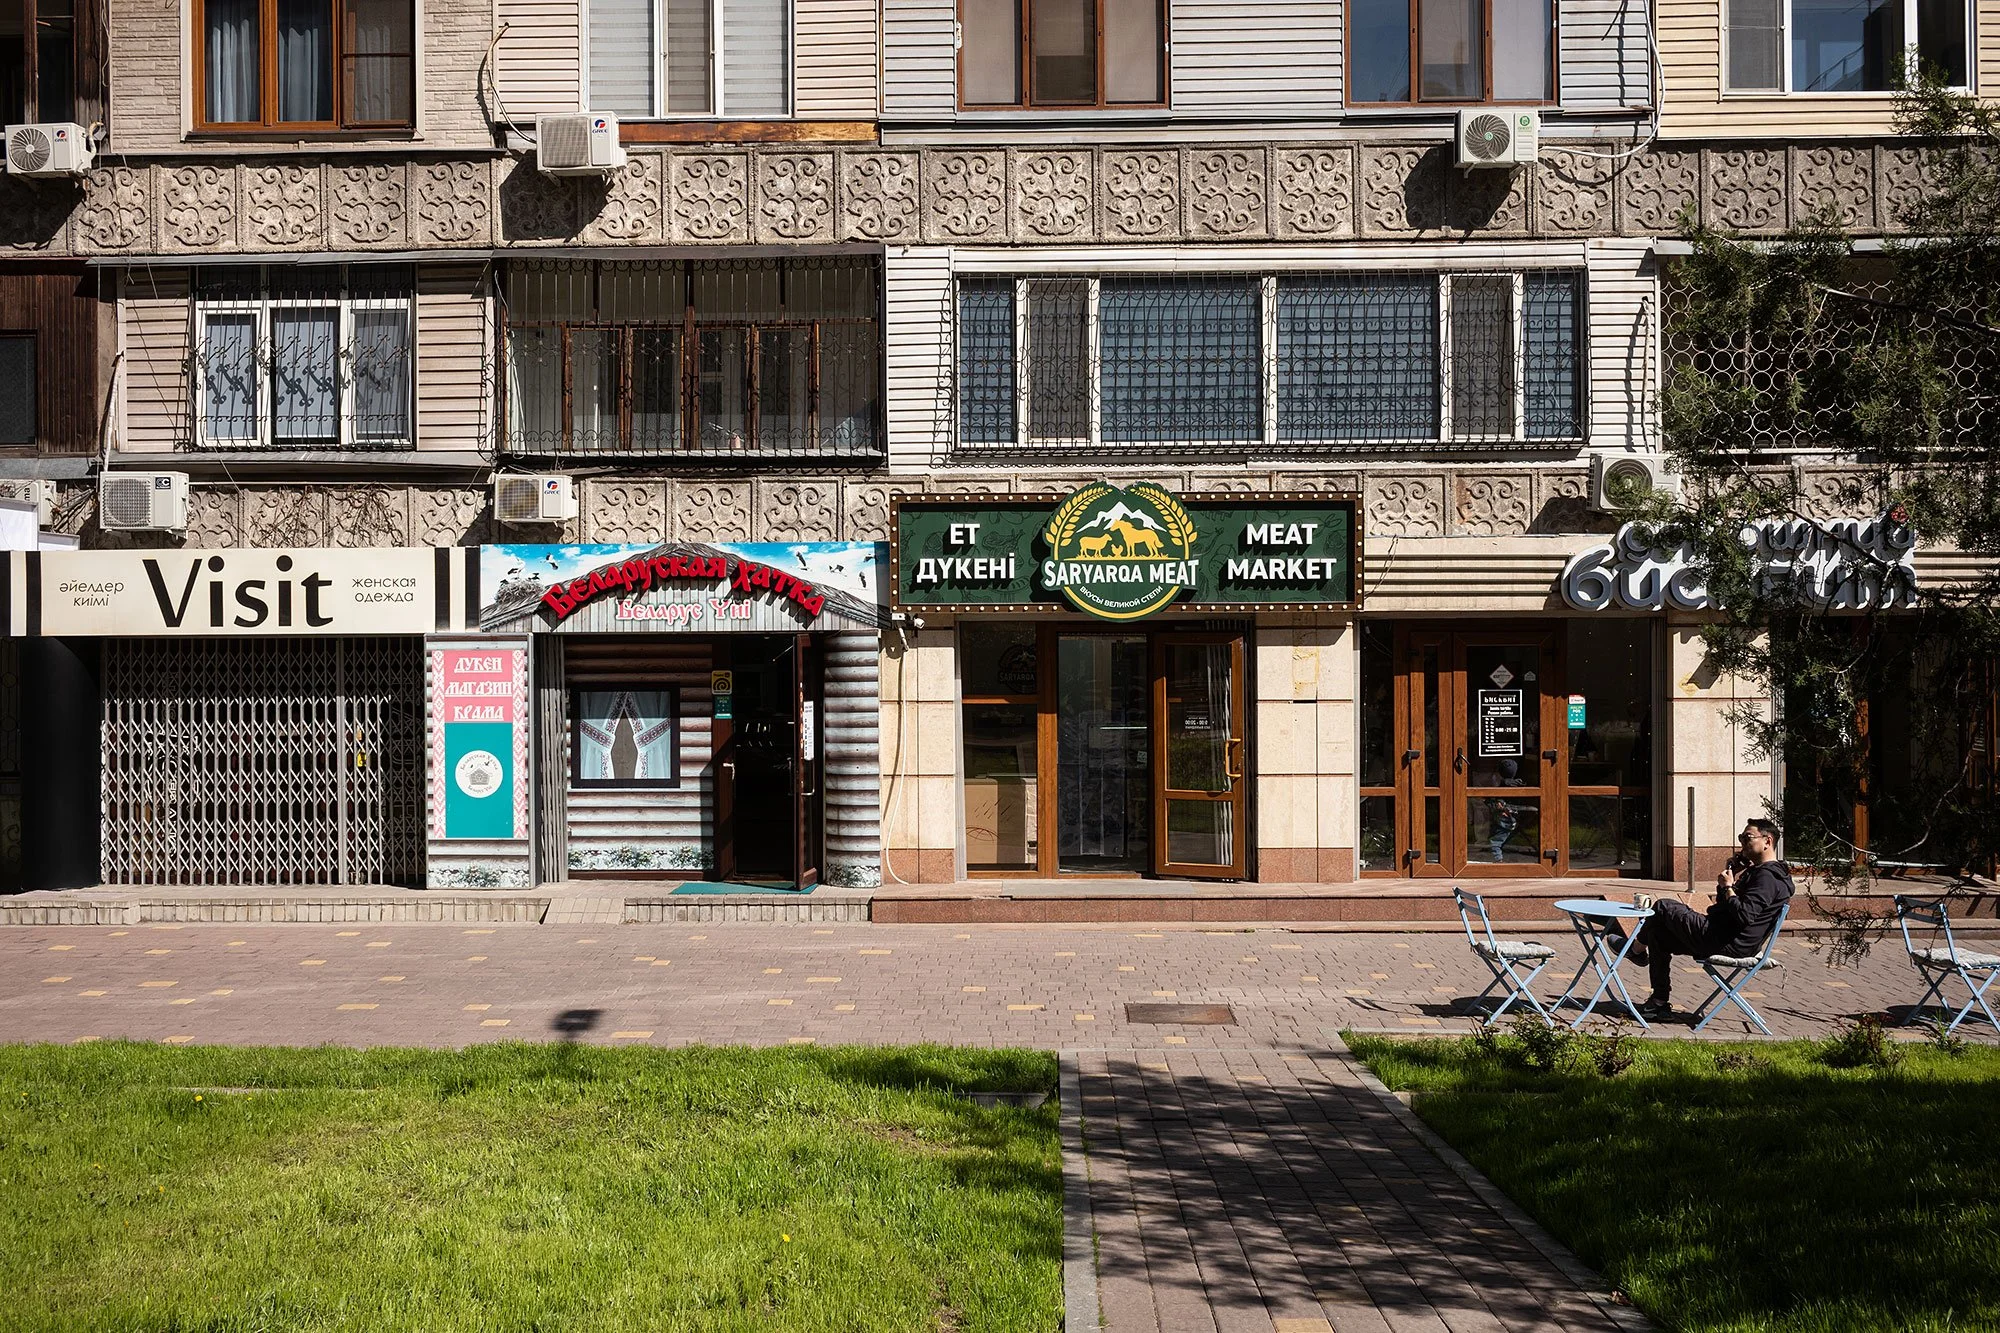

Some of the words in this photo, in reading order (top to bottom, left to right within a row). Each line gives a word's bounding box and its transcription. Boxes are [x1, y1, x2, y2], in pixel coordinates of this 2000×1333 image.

[951, 523, 981, 545] ЕТ
[1247, 523, 1318, 545] MEAT
[1044, 559, 1144, 587] SARYARQA
[1149, 559, 1199, 587] MEAT
[1227, 557, 1337, 580] MARKET
[59, 579, 125, 595] әйелдер
[142, 555, 334, 628] Visit
[352, 577, 416, 588] женская
[73, 593, 110, 607] киімі
[354, 592, 414, 603] одежда
[1079, 585, 1104, 605] ВКУСЫ
[1104, 598, 1141, 608] ВЕЛИКОЙ
[1140, 584, 1164, 604] СТЕПИ
[444, 680, 513, 697] МАГАЗИН
[453, 704, 504, 721] КРАМА
